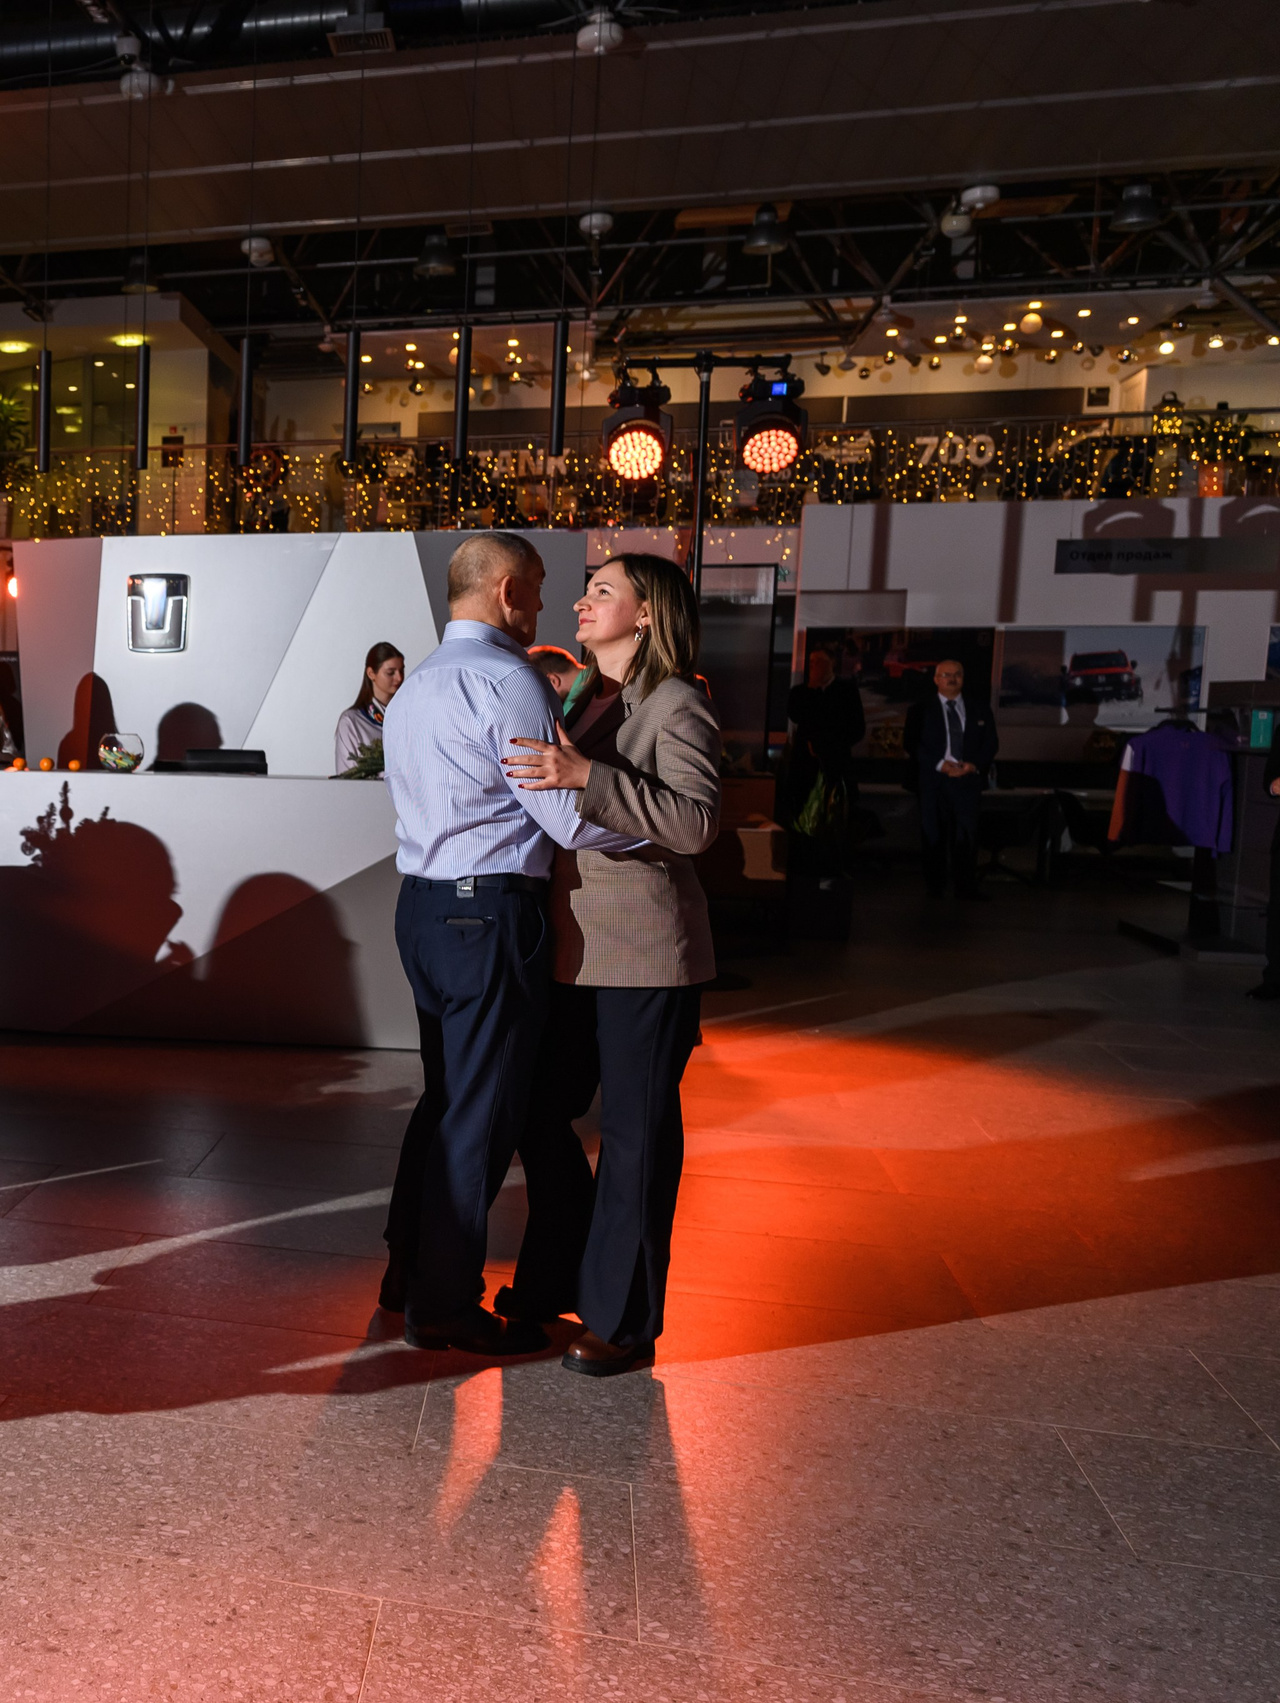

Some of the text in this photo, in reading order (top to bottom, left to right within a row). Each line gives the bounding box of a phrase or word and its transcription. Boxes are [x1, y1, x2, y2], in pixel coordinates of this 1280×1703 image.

[915, 434, 995, 466] 700
[1070, 550, 1173, 562] Отдел продаж
